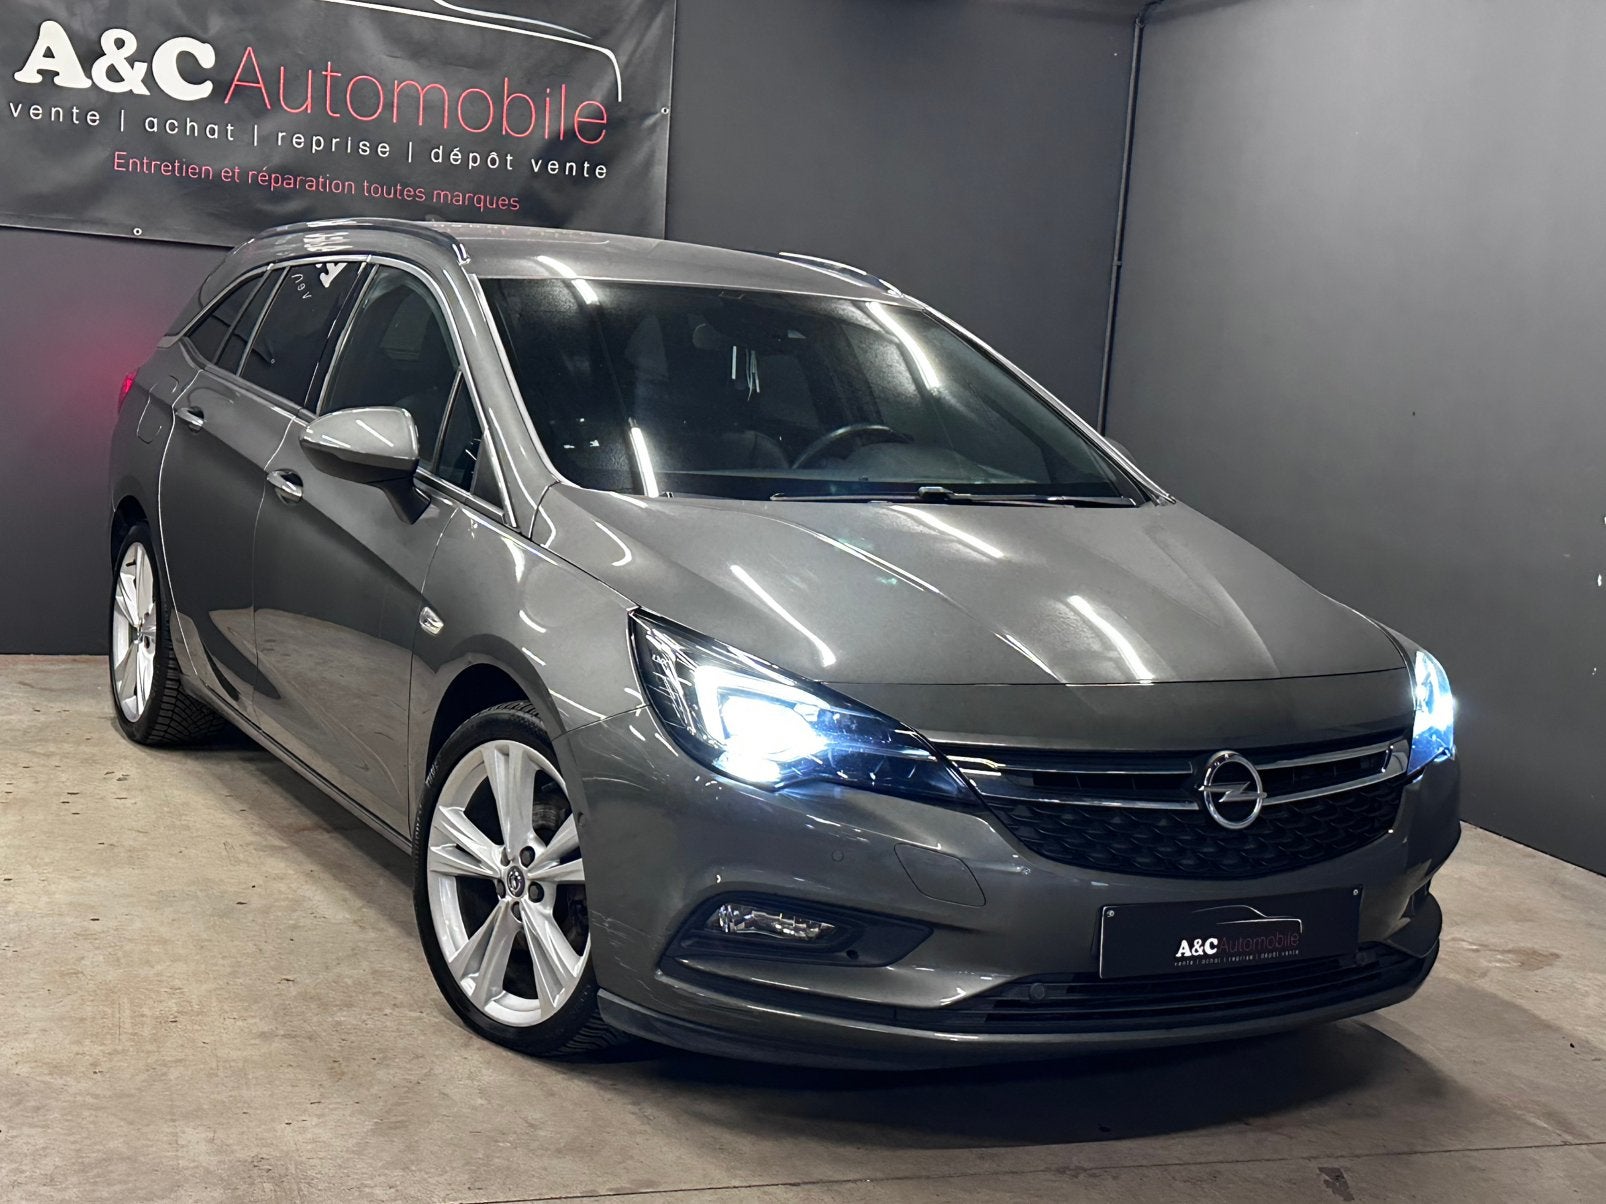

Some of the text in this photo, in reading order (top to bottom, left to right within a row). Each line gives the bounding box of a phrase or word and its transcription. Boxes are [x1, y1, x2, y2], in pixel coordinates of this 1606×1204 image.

[14, 20, 608, 145] A&C Automobile
[9, 102, 608, 179] vente achat reprise dépôt vente
[113, 151, 520, 212] Entretien et réparation toutes marques
[1175, 930, 1299, 957] A&C Automobile
